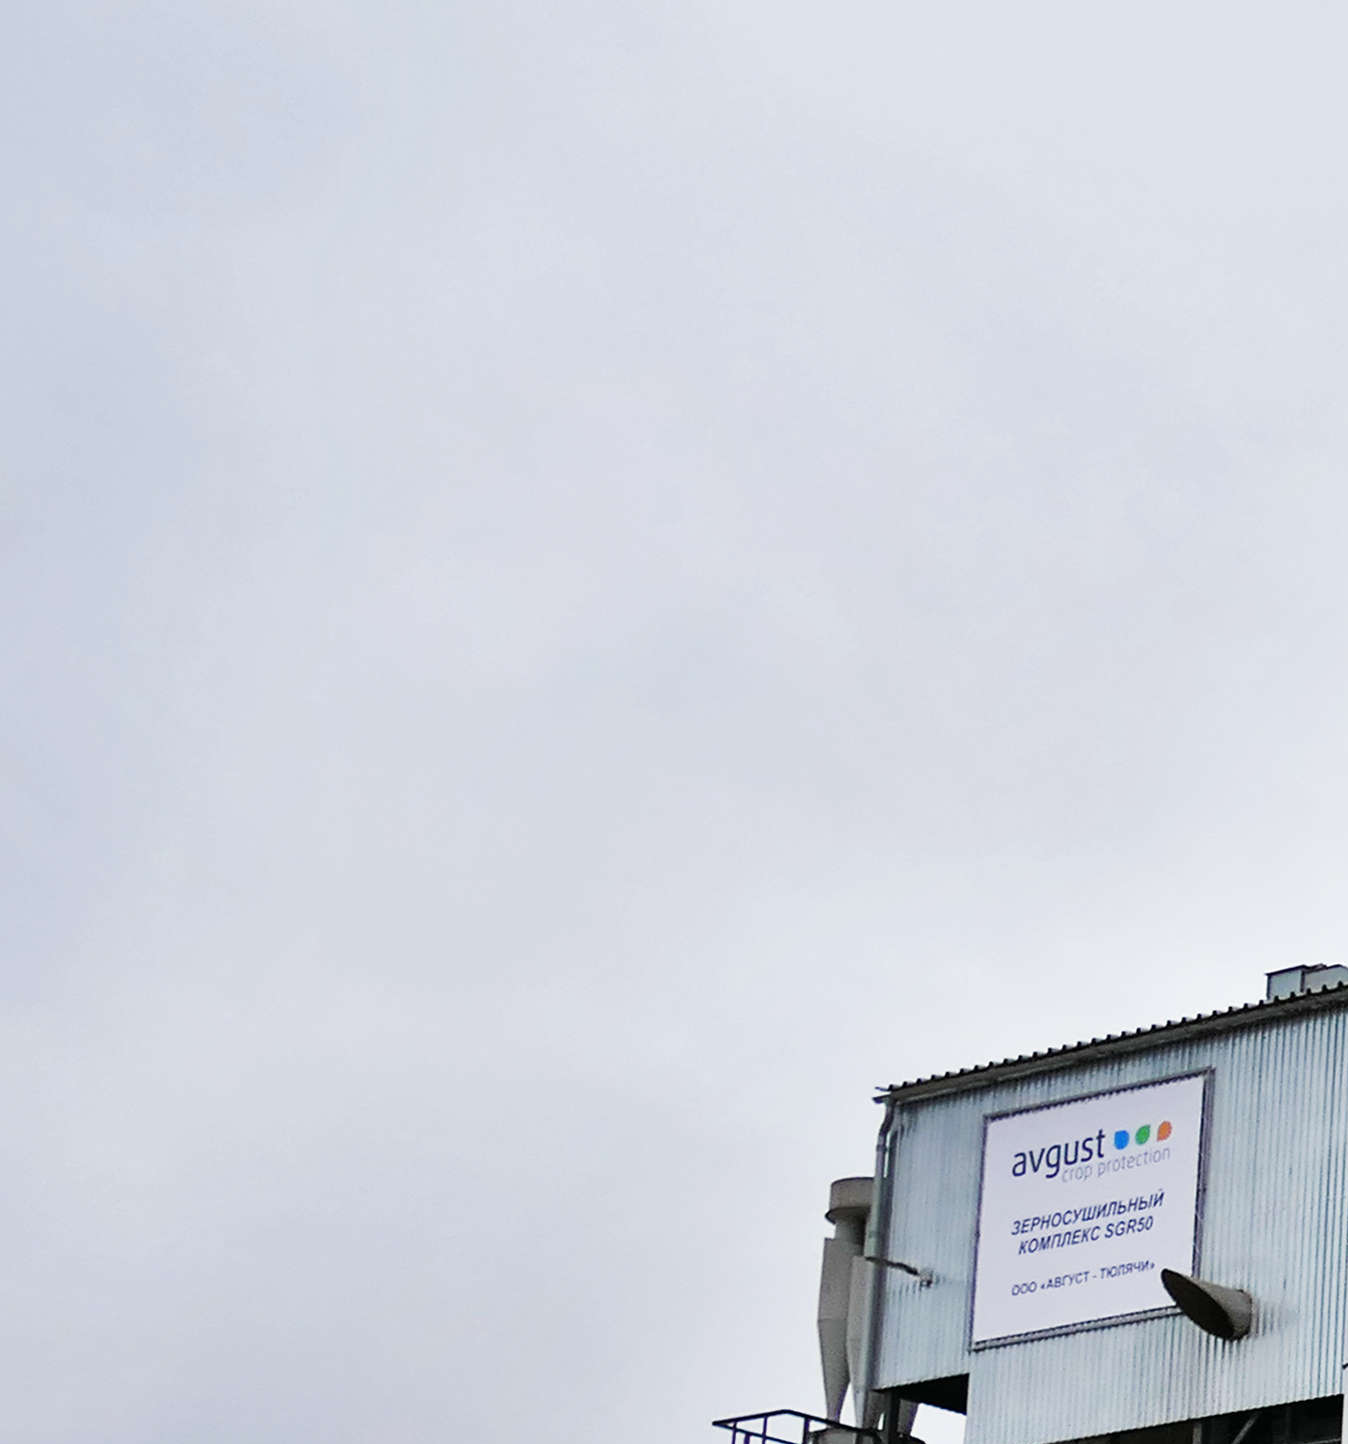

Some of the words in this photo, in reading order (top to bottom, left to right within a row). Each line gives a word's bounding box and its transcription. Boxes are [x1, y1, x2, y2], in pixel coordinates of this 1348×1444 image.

[1011, 1129, 1106, 1179] avgust
[1061, 1164, 1093, 1183] crop
[1097, 1147, 1171, 1178] protection
[1011, 1188, 1165, 1236] ЗЕРНОСУШИЛЬНЫЙ
[1018, 1226, 1101, 1256] КОМПЛЕКС
[1104, 1215, 1154, 1239] SGR50
[1011, 1281, 1038, 1296] ООО
